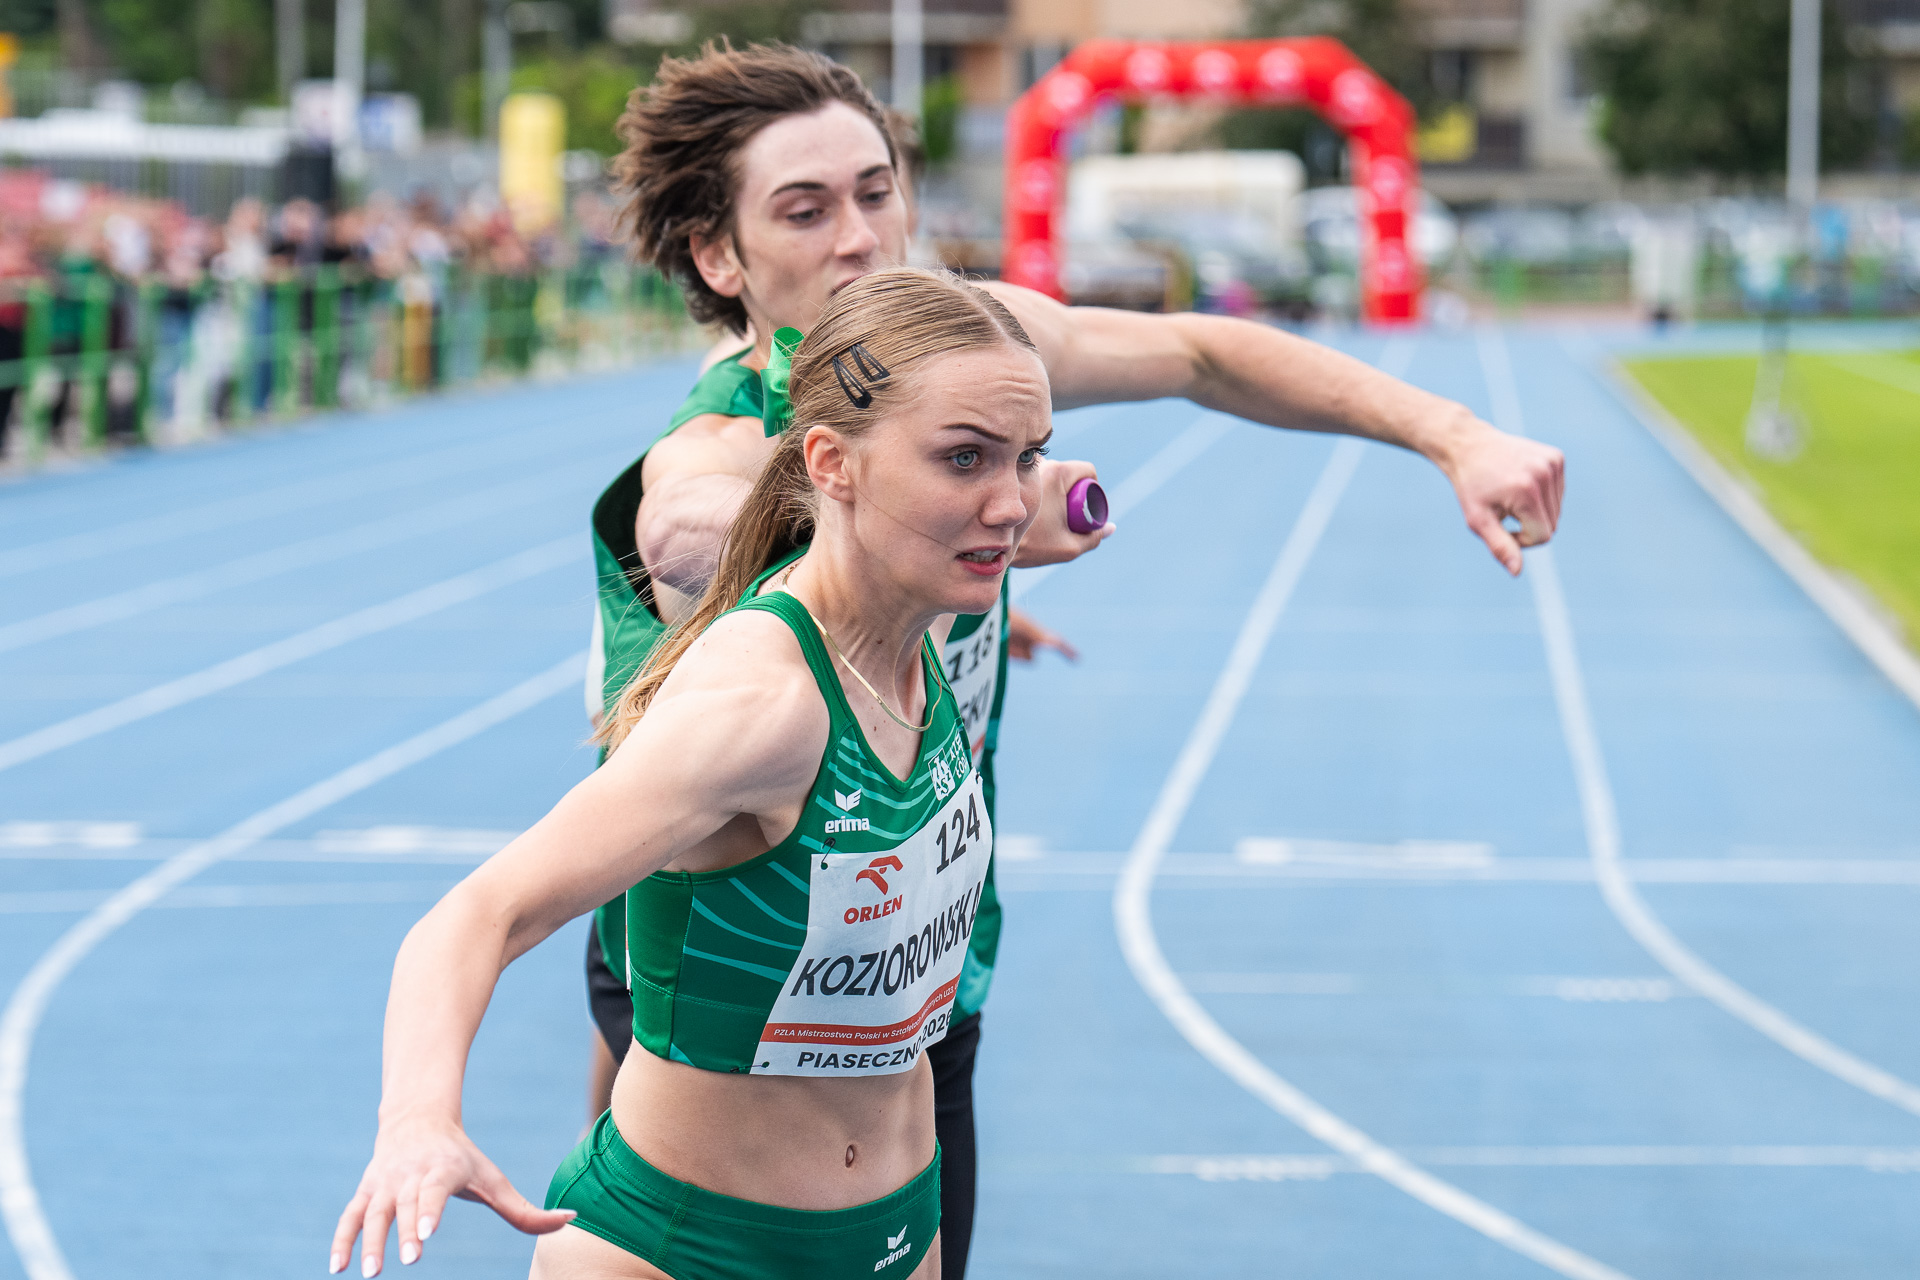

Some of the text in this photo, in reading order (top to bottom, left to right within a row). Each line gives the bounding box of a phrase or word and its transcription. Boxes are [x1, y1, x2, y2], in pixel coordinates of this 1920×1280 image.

[825, 816, 870, 834] erima
[936, 793, 981, 875] 124
[844, 894, 903, 925] ORLEN
[790, 881, 981, 997] KOZIOROWSKA
[773, 1028, 796, 1037] PZLA
[798, 1030, 853, 1039] Mistrzostwa
[854, 1031, 881, 1040] Polski
[797, 1036, 922, 1068] PIASECZNO
[874, 1243, 911, 1272] erima
